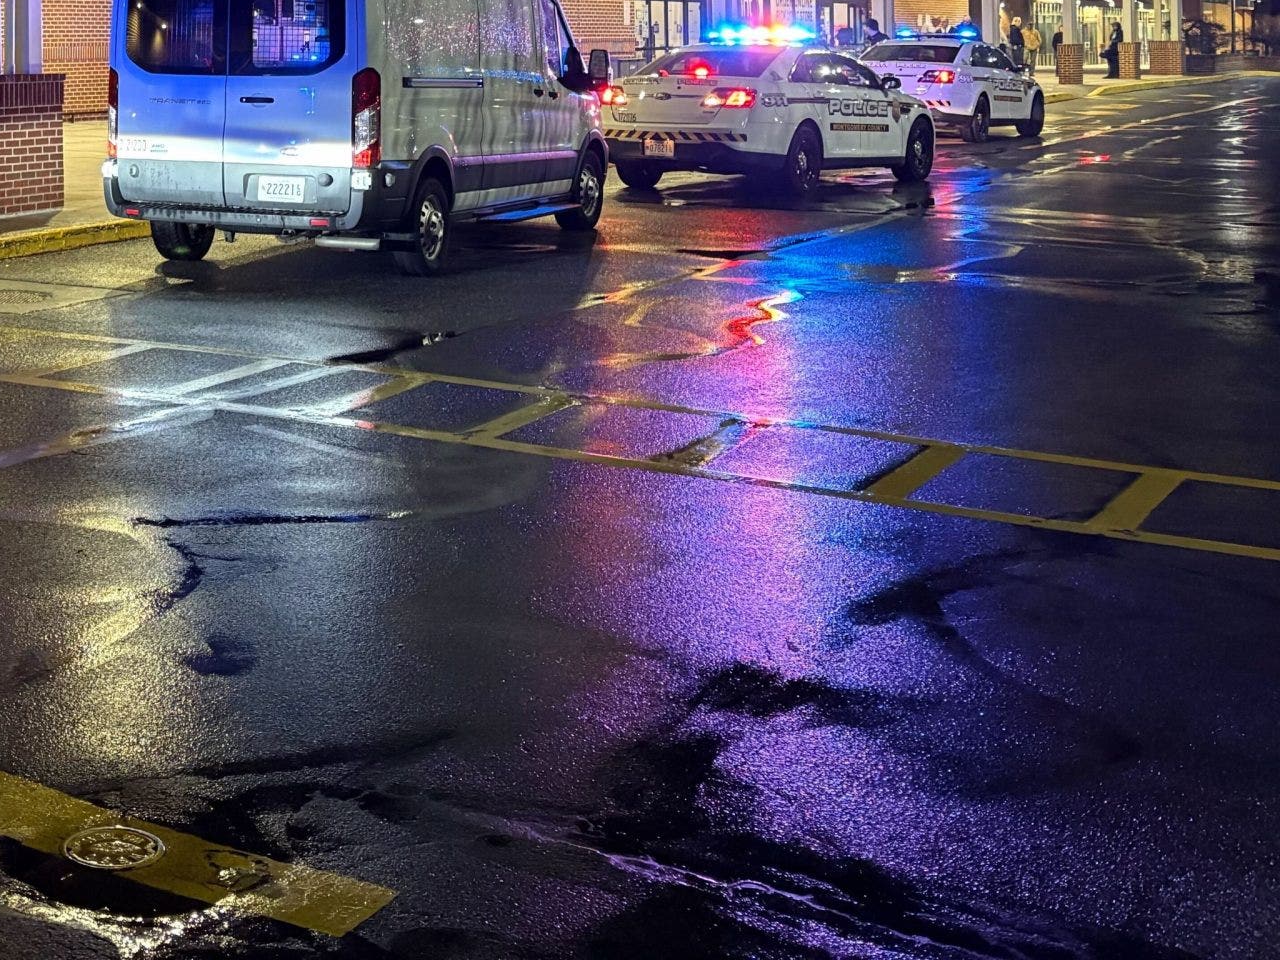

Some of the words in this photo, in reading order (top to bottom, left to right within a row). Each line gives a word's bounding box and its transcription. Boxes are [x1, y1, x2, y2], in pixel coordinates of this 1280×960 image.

[992, 79, 1022, 92] POLICE
[761, 95, 788, 107] 911
[828, 98, 889, 117] POLICE
